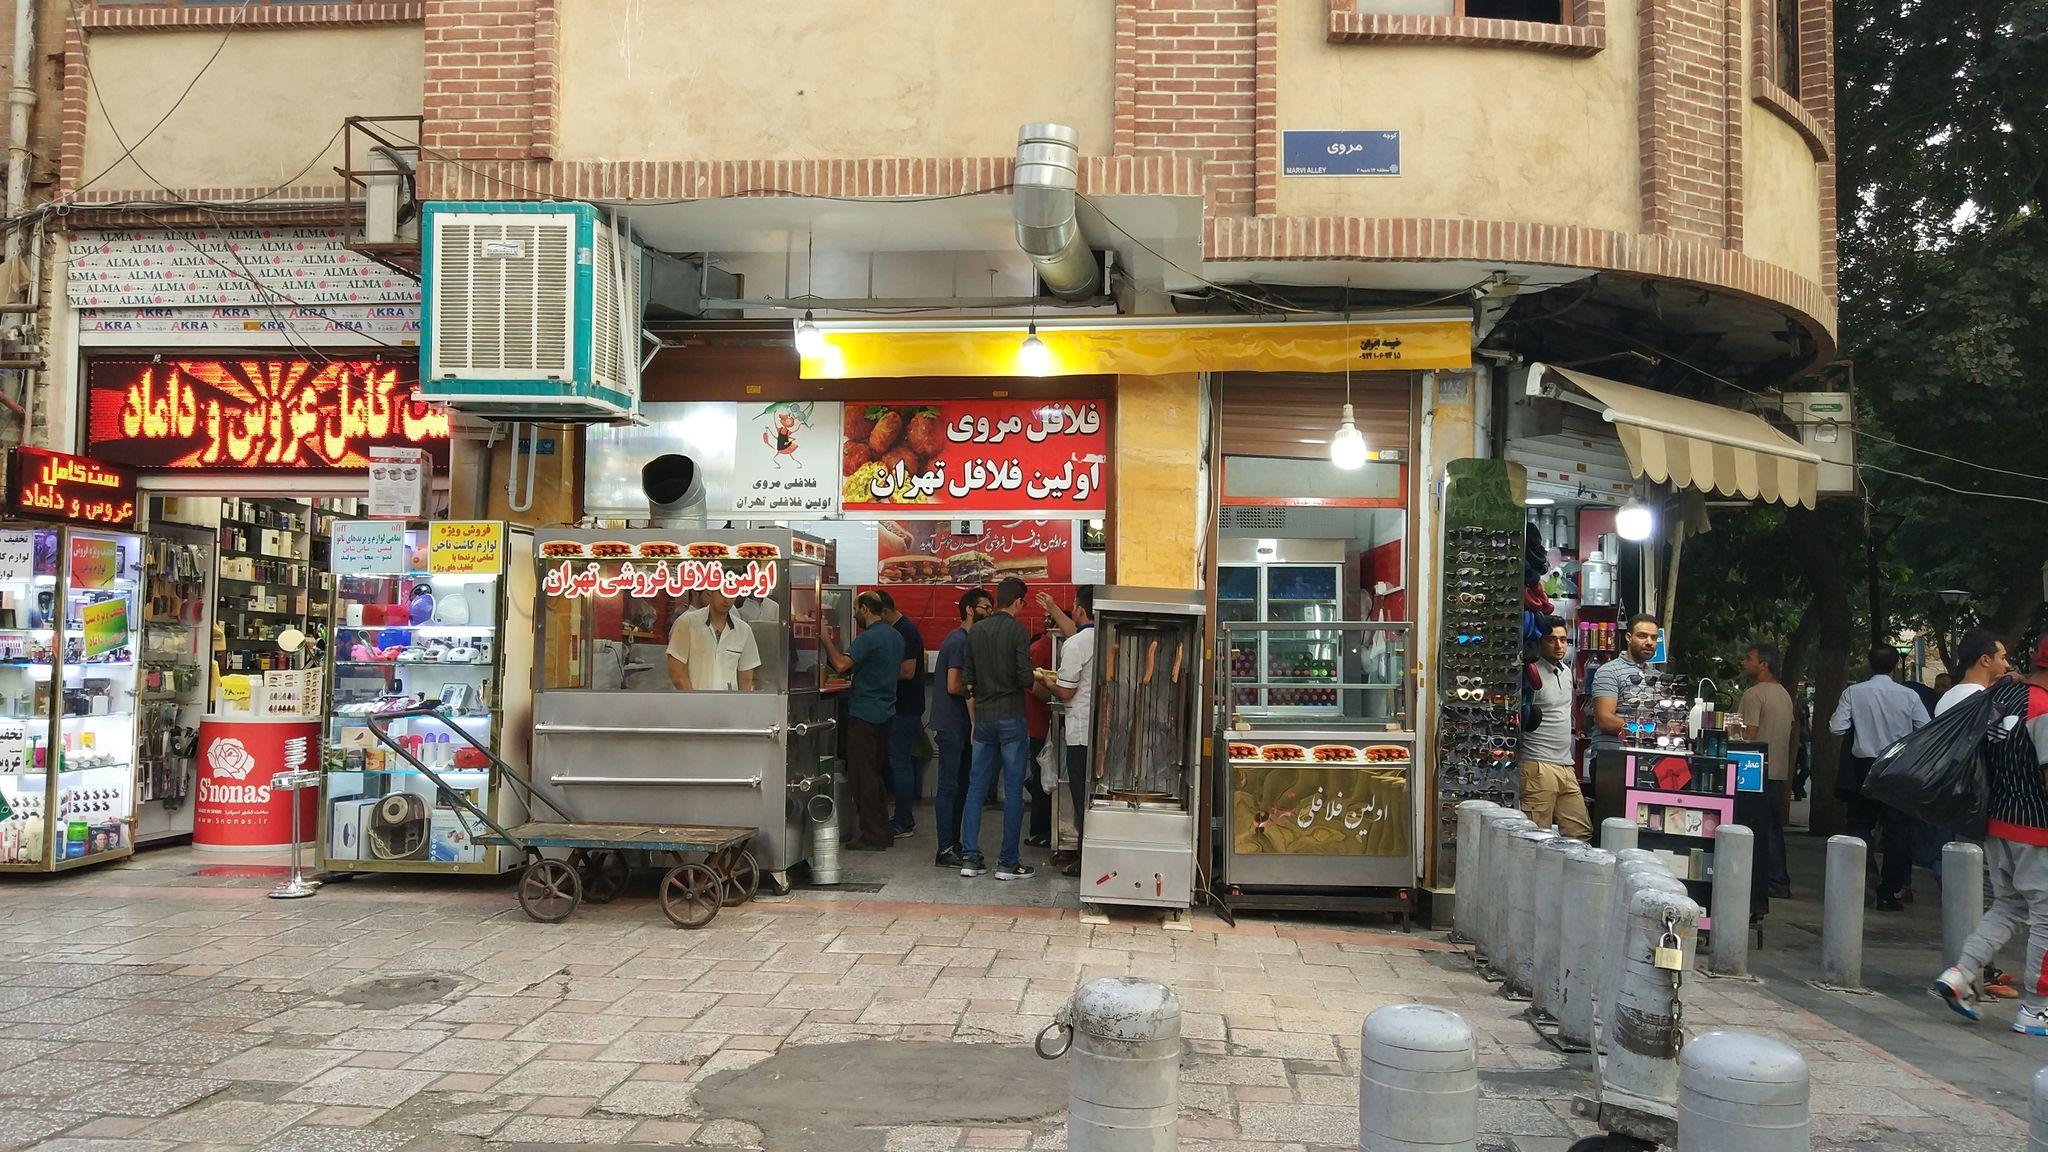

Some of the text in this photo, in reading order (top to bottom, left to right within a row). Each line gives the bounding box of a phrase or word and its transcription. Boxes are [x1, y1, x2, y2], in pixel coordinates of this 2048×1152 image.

[1327, 143, 1363, 155] مروی
[100, 229, 326, 241] ALMA ALMA ALMA ALMA
[130, 245, 164, 253] ALMA
[195, 244, 228, 252] ALMA
[259, 243, 294, 251] ALMA
[171, 258, 205, 266] ALMA
[237, 256, 270, 264] ALMA
[301, 256, 335, 264] ALMA
[128, 271, 162, 279] ALMA
[193, 270, 227, 278] ALMA
[258, 269, 292, 277] ALMA
[324, 268, 358, 276] ALMA
[87, 284, 120, 292] ALMA
[152, 283, 186, 291] ALMA
[216, 282, 250, 290] ALMA
[282, 281, 316, 289] ALMA
[119, 296, 153, 304] ALMA
[184, 295, 218, 303] ALMA
[249, 294, 283, 302] ALMA
[314, 293, 347, 301] ALMA
[379, 292, 413, 300] ALMA
[80, 309, 97, 317] RA
[136, 308, 173, 318] AKRA
[213, 308, 249, 318] AKRA
[289, 308, 327, 318] AKRA
[366, 308, 404, 318] AKRA
[96, 322, 132, 330] AKRA
[171, 322, 208, 330] AKRA
[325, 322, 362, 331] AKRA
[402, 321, 420, 331] AK
[123, 368, 197, 438] داماد
[324, 369, 397, 459] کامل
[228, 386, 318, 462] عروس
[946, 403, 1100, 442] فلافل مروی
[202, 400, 221, 462] و
[42, 457, 119, 487] ست کامل
[870, 459, 946, 498] تهران
[948, 458, 1023, 498] فلافل
[752, 478, 816, 489] فلافلی مروی
[22, 484, 133, 522] عروس و داماد
[736, 496, 831, 509] اولین فلافلی تهران
[441, 524, 491, 536] فروش ویژه
[4, 535, 28, 545] تخفیف
[950, 528, 991, 550] تهران
[985, 534, 1005, 552] فروشی
[1003, 529, 1040, 552] فلافل
[1039, 535, 1062, 552] اولین
[432, 540, 496, 552] لوازم کاشت ناخن
[458, 554, 475, 562] برندها
[477, 554, 494, 562] تمامی
[545, 561, 775, 597] اولین فلافل فروشی تهران
[0, 728, 23, 743] تخفی
[1743, 760, 1760, 770] عطر
[1297, 786, 1388, 836] اولین فلافلی
